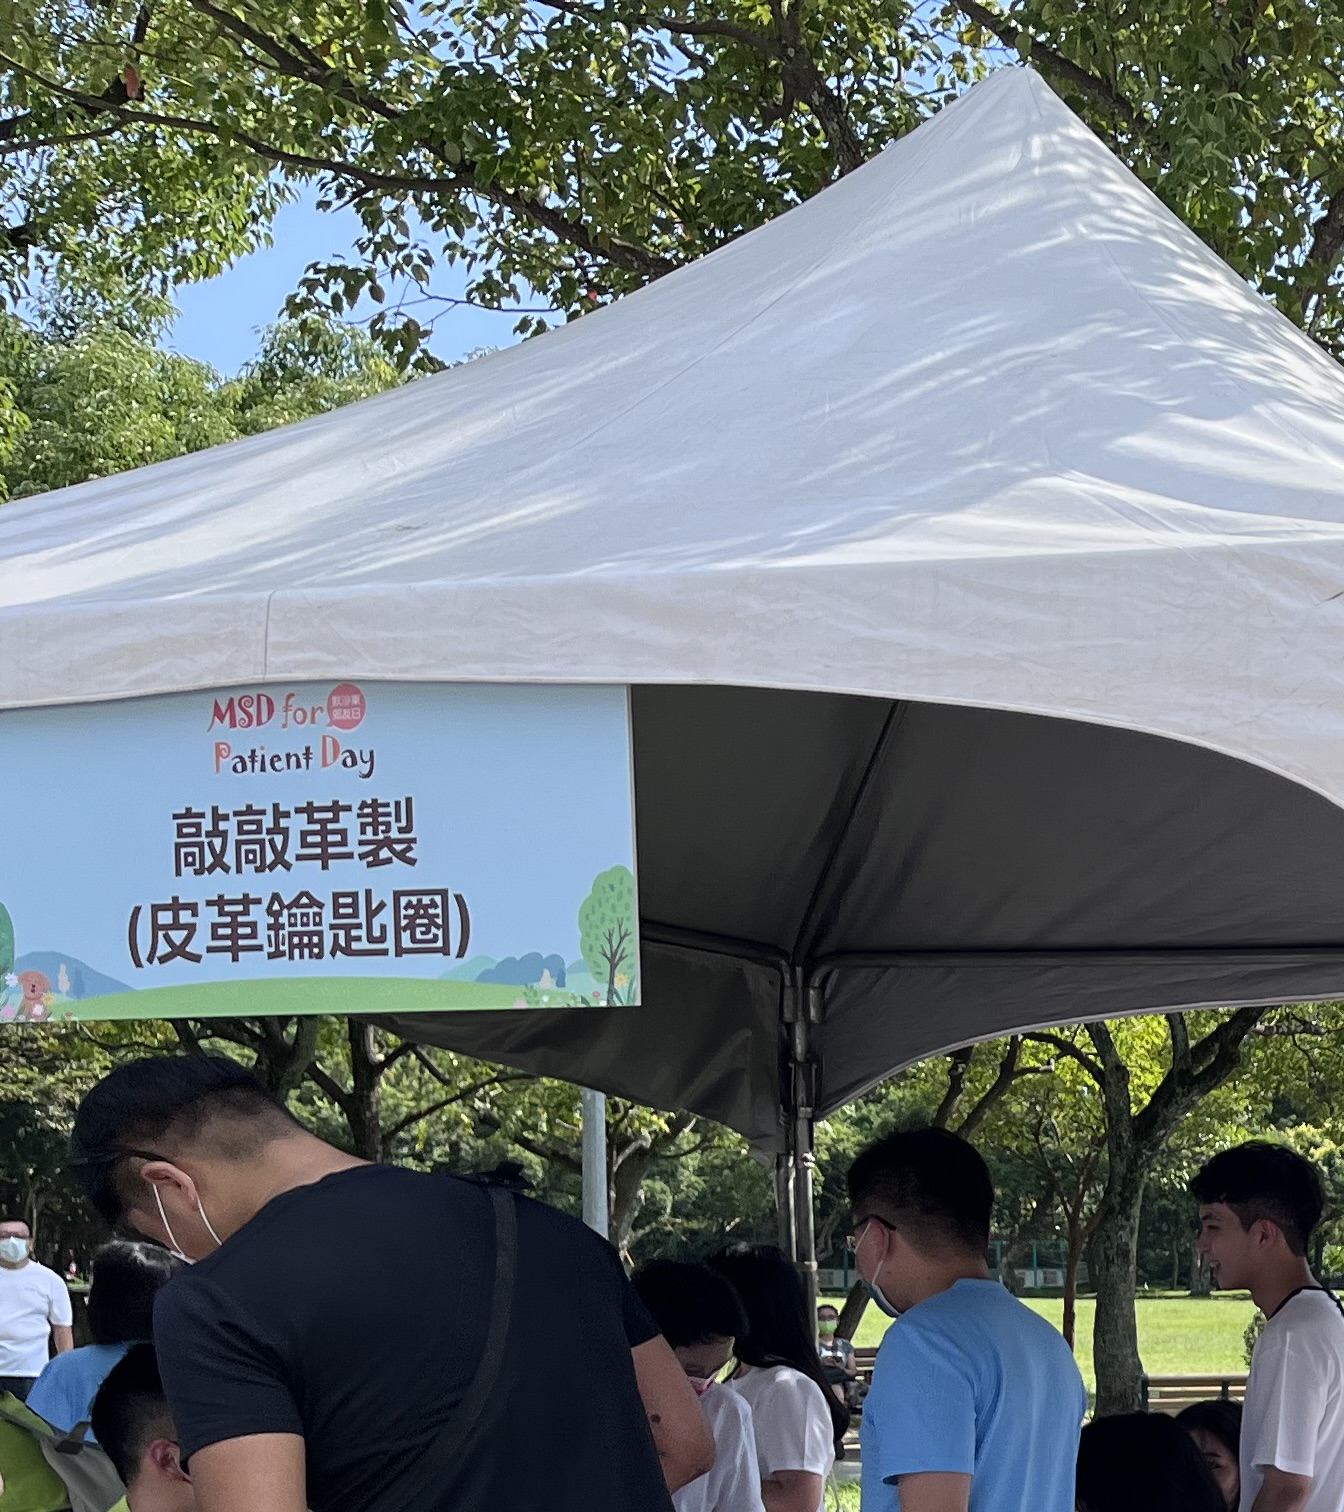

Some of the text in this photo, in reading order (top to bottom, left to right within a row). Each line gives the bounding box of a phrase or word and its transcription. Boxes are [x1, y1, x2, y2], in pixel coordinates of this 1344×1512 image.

[207, 692, 324, 732] MSD for
[214, 735, 374, 779] Patient Day
[172, 796, 418, 877] 敲敲革製
[128, 888, 471, 969] (皮革鑰匙圈)
